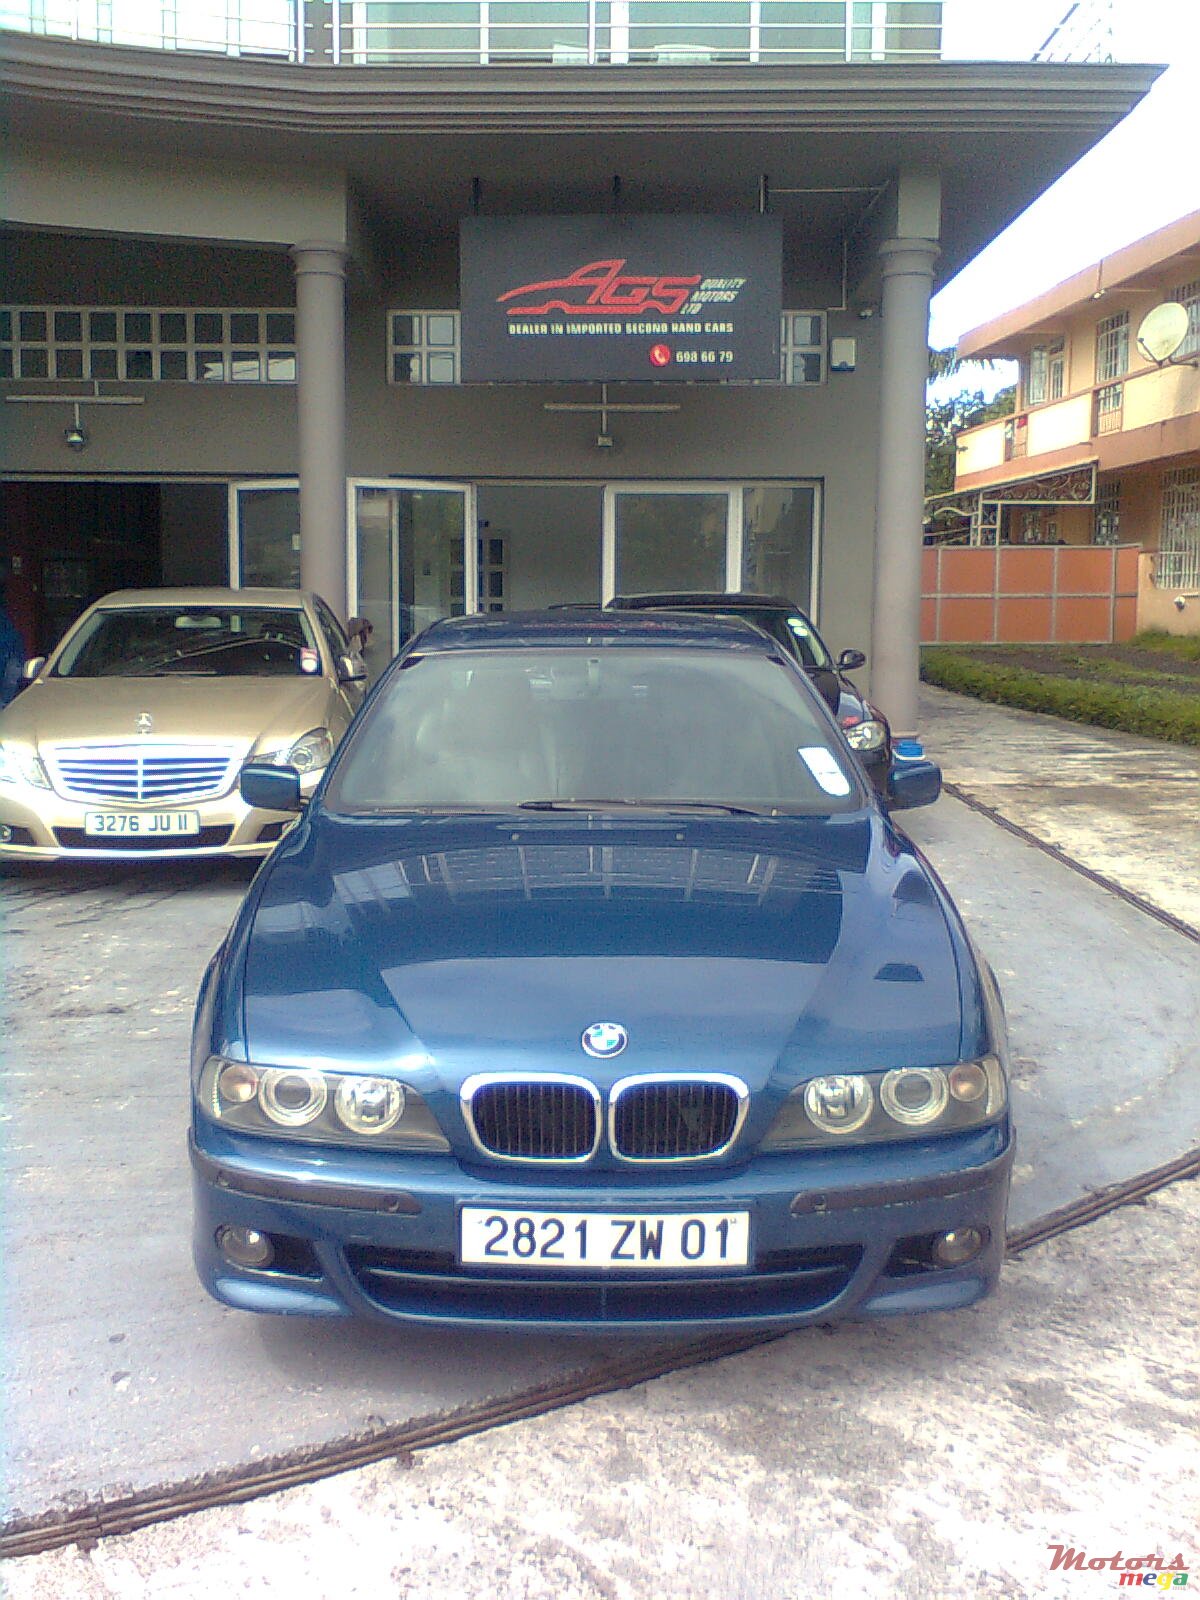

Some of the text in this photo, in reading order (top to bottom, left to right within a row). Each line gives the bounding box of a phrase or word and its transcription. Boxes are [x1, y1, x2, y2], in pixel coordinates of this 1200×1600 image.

[560, 259, 701, 315] AGS
[690, 291, 739, 302] MOTORS
[680, 303, 702, 315] LTD
[509, 322, 734, 335] DEALER IN IMPORTED SECOND HAND CARS
[676, 350, 734, 363] 698 66 79
[94, 814, 140, 832] 3276
[148, 814, 171, 832] JU
[484, 1215, 729, 1260] 2821 ZW 01
